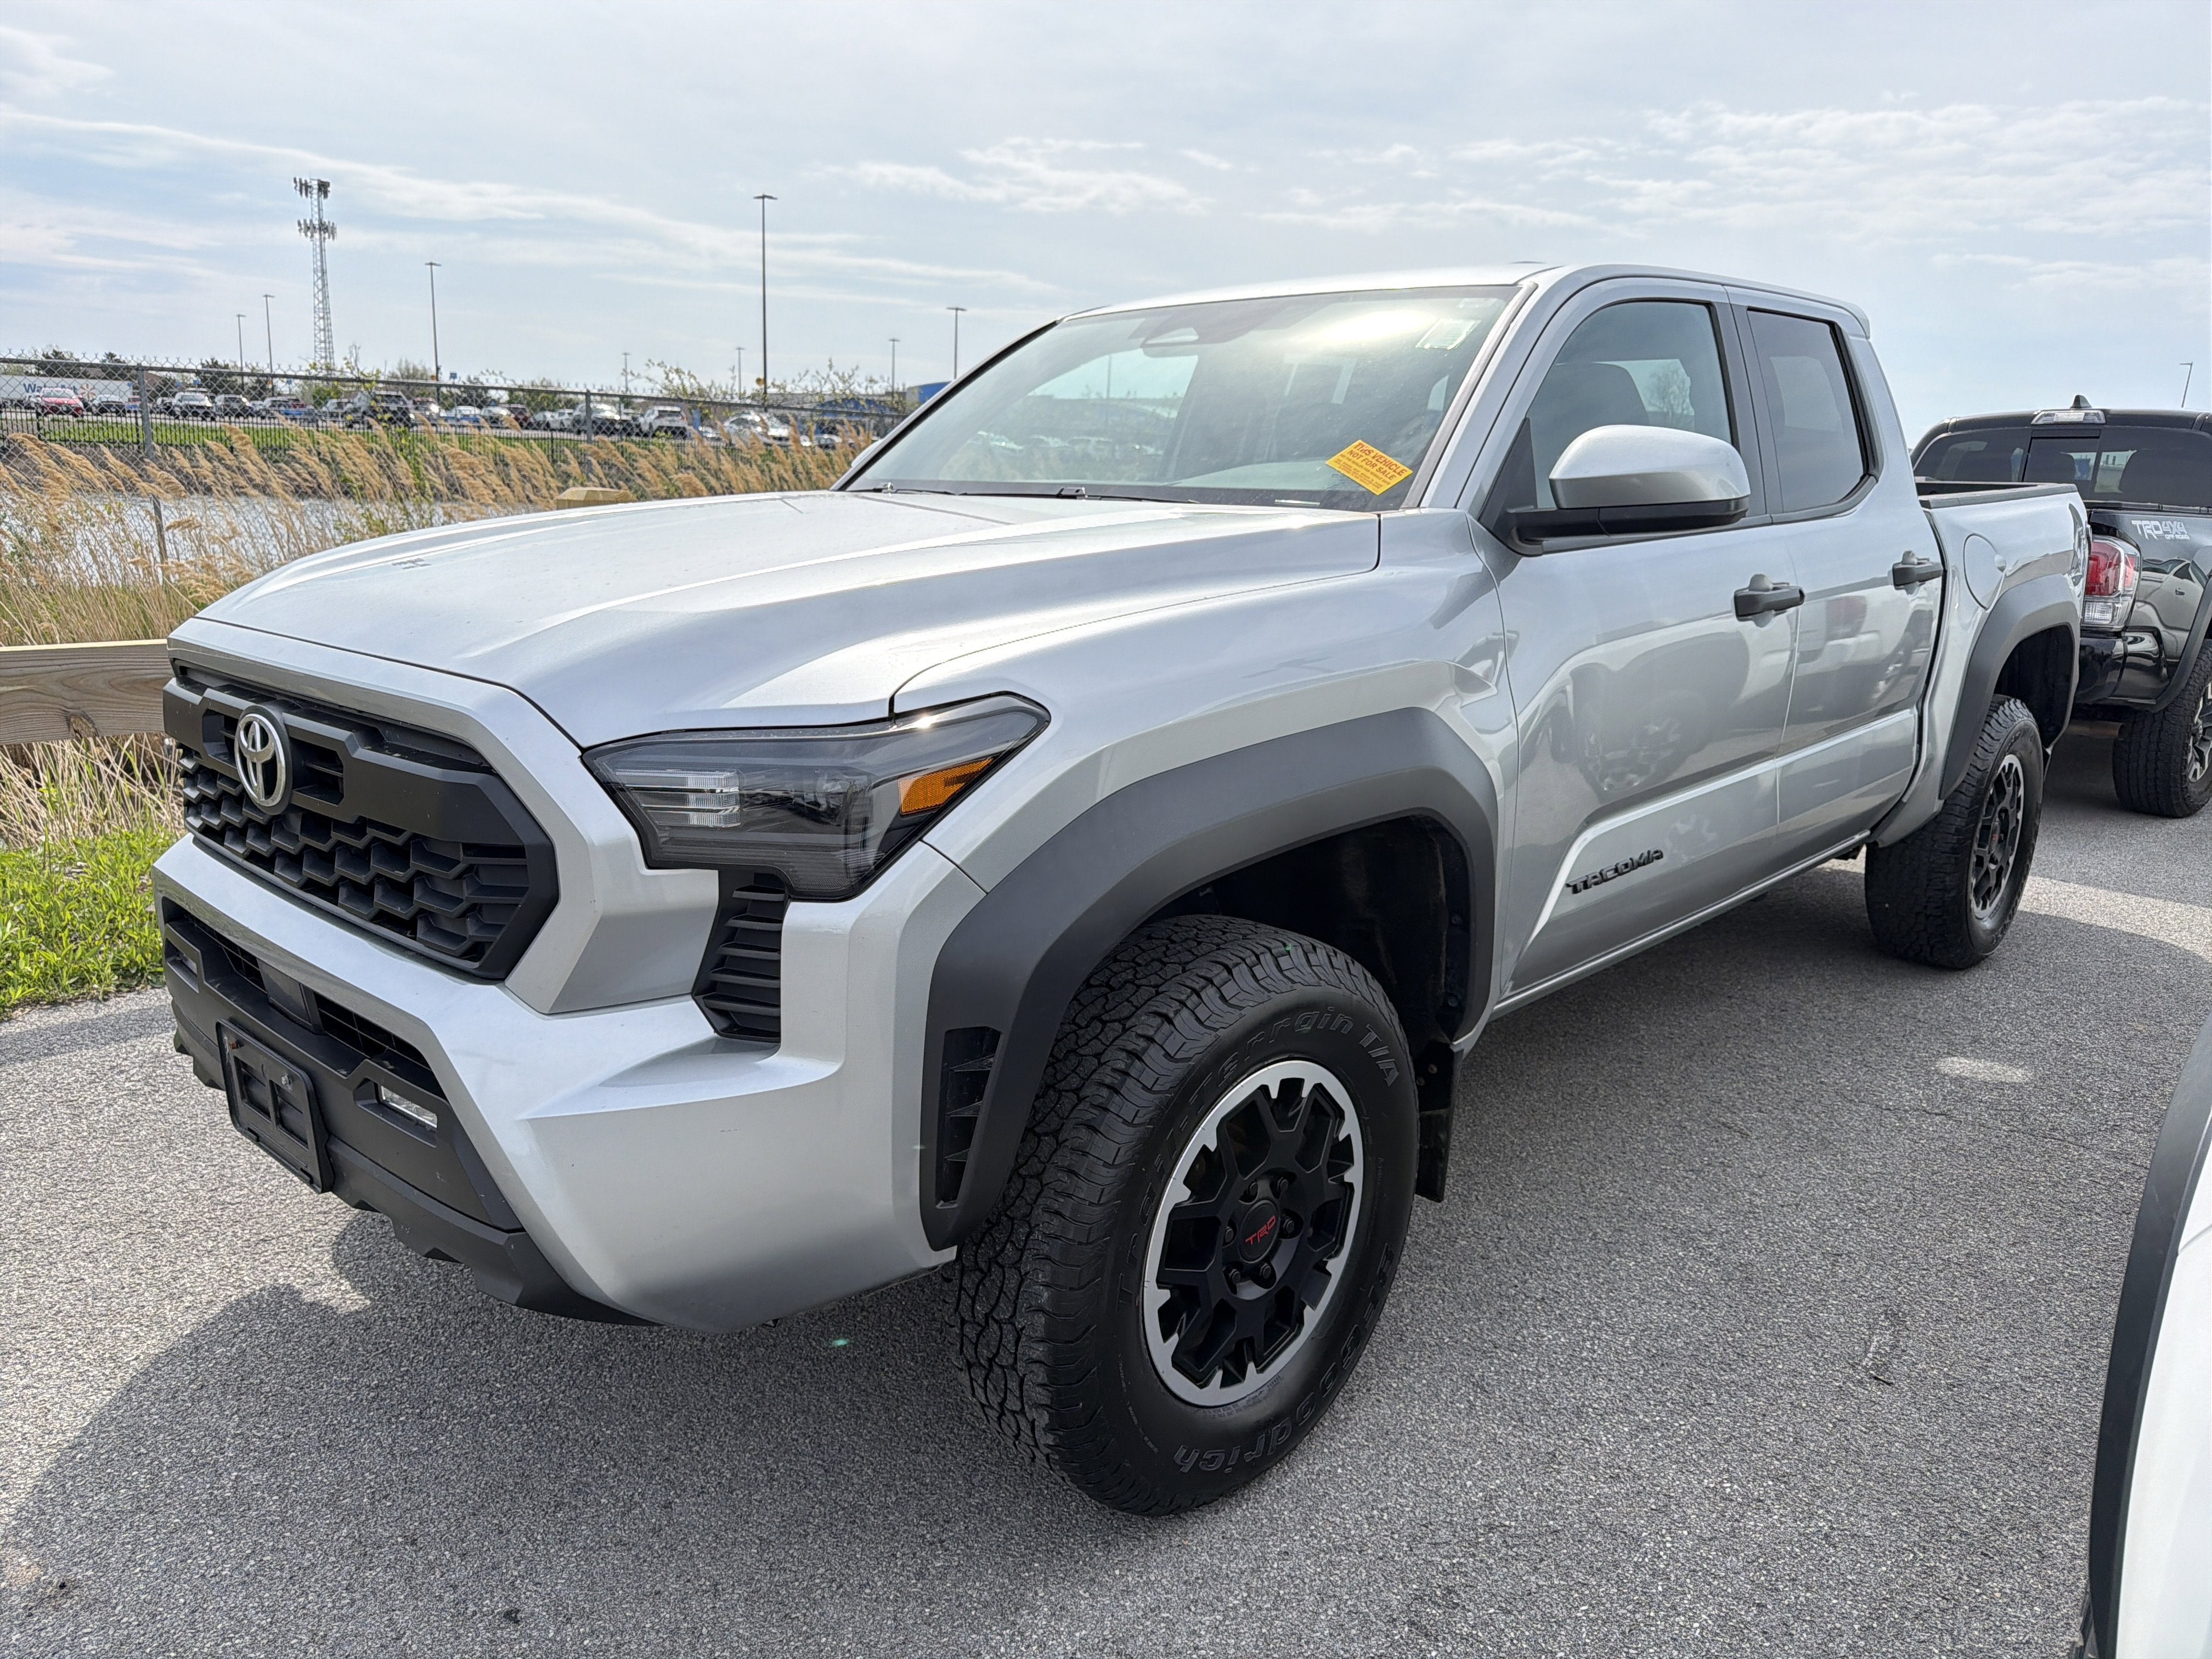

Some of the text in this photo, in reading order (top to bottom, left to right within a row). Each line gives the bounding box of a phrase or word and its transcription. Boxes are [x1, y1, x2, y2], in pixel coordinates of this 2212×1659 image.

[1347, 449, 1397, 481] NOT FOR SALE
[1352, 442, 1374, 456] THIS
[1372, 453, 1408, 476] VEHICLE
[2131, 520, 2163, 540] TRD
[1565, 848, 1664, 894] TACOMA
[1358, 1024, 1400, 1087] T/A
[1245, 1215, 1277, 1245] TRD
